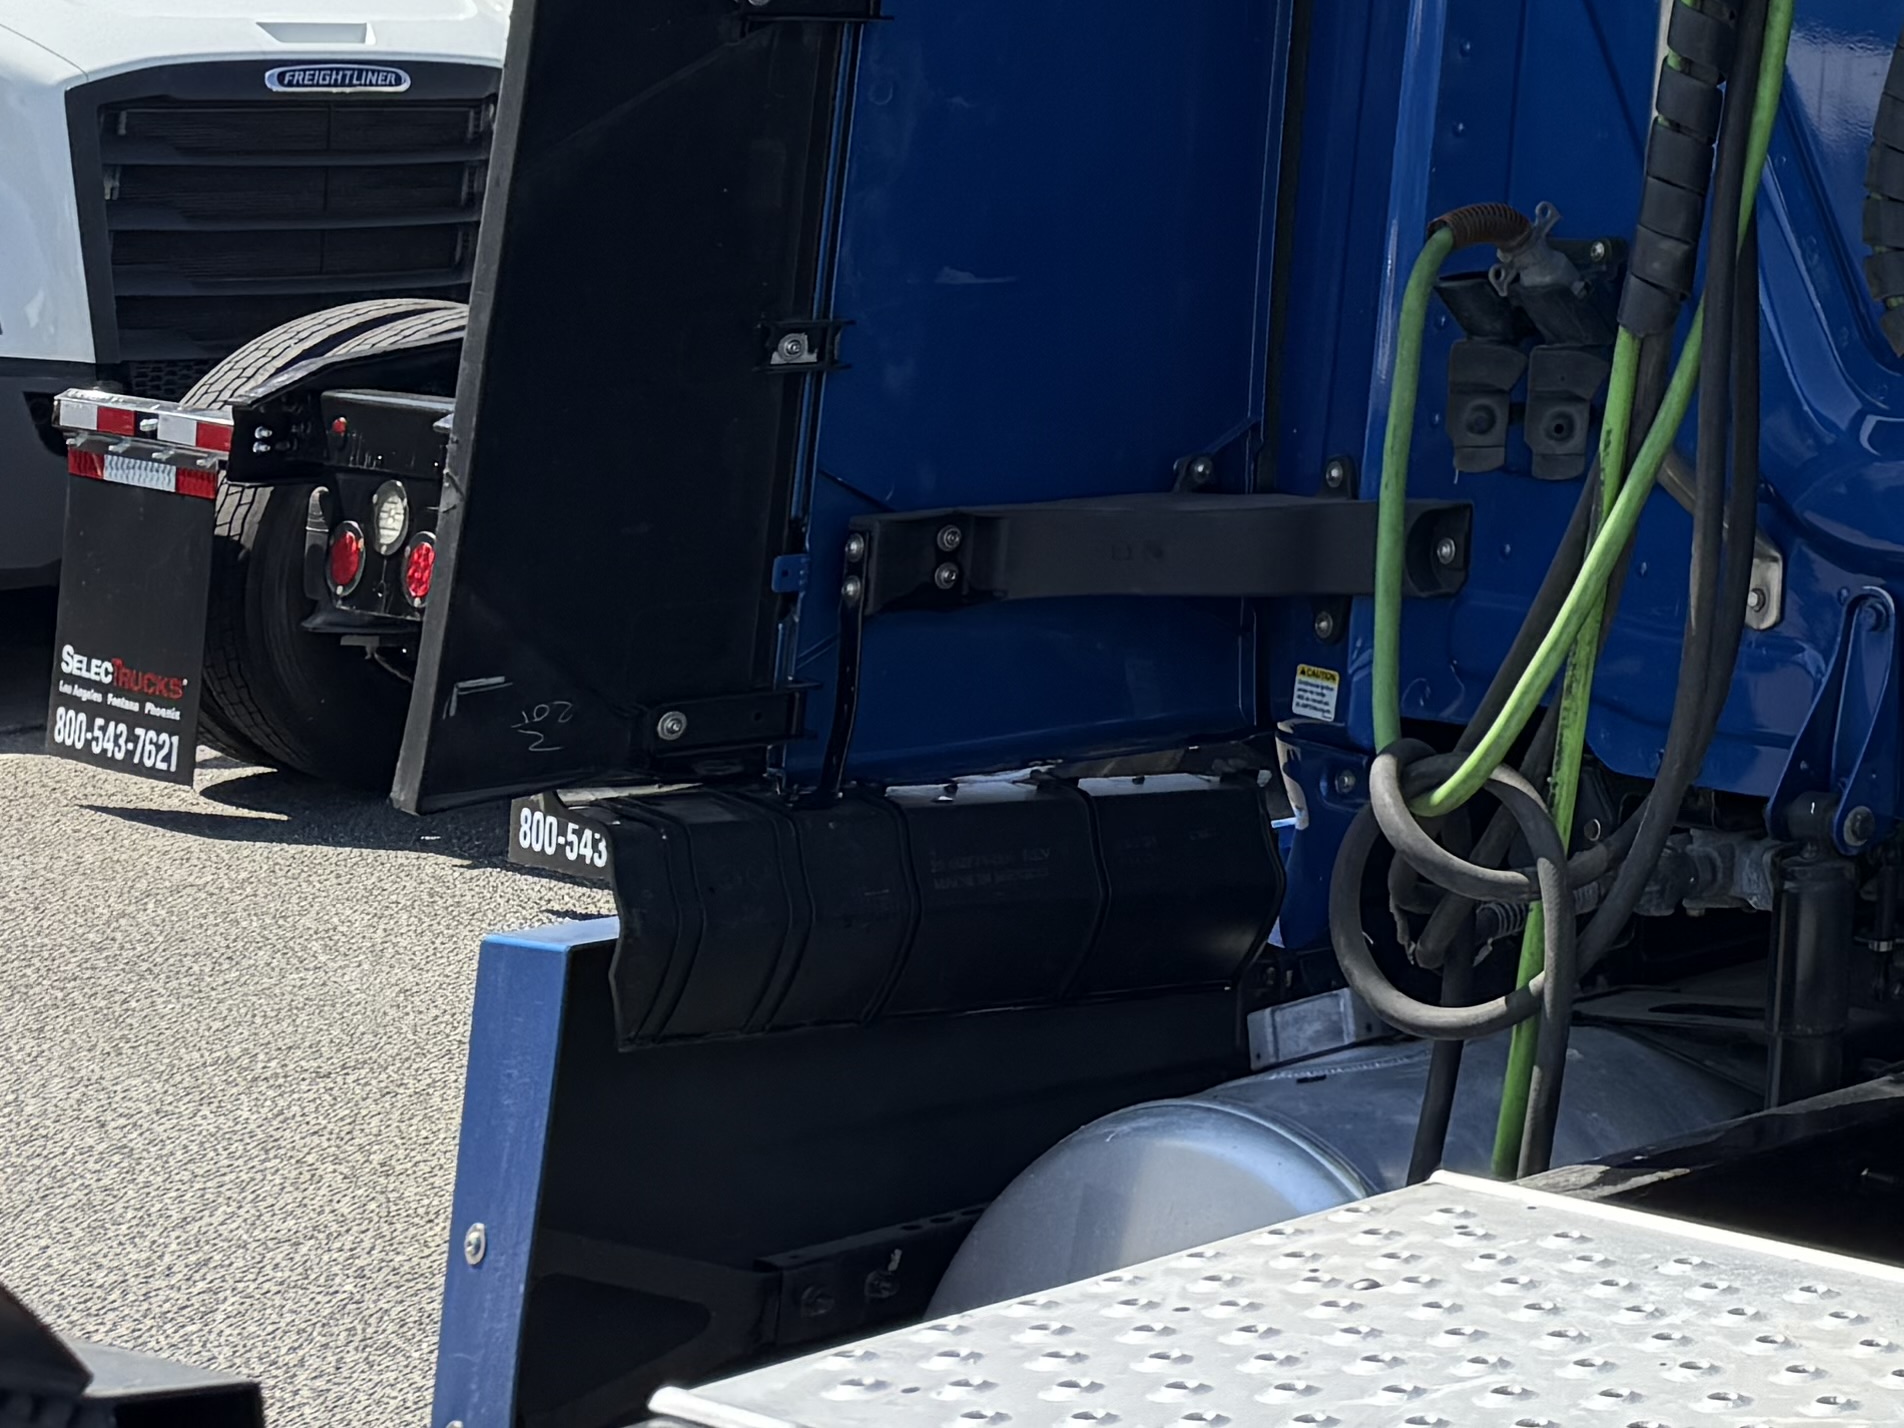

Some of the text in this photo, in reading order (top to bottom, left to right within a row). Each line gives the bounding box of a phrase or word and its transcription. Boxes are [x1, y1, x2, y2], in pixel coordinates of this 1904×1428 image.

[283, 69, 396, 86] FREIGHTLINER
[58, 680, 181, 721] Los Angeles Fontana Phoenix
[54, 706, 180, 773] 800-543-7621
